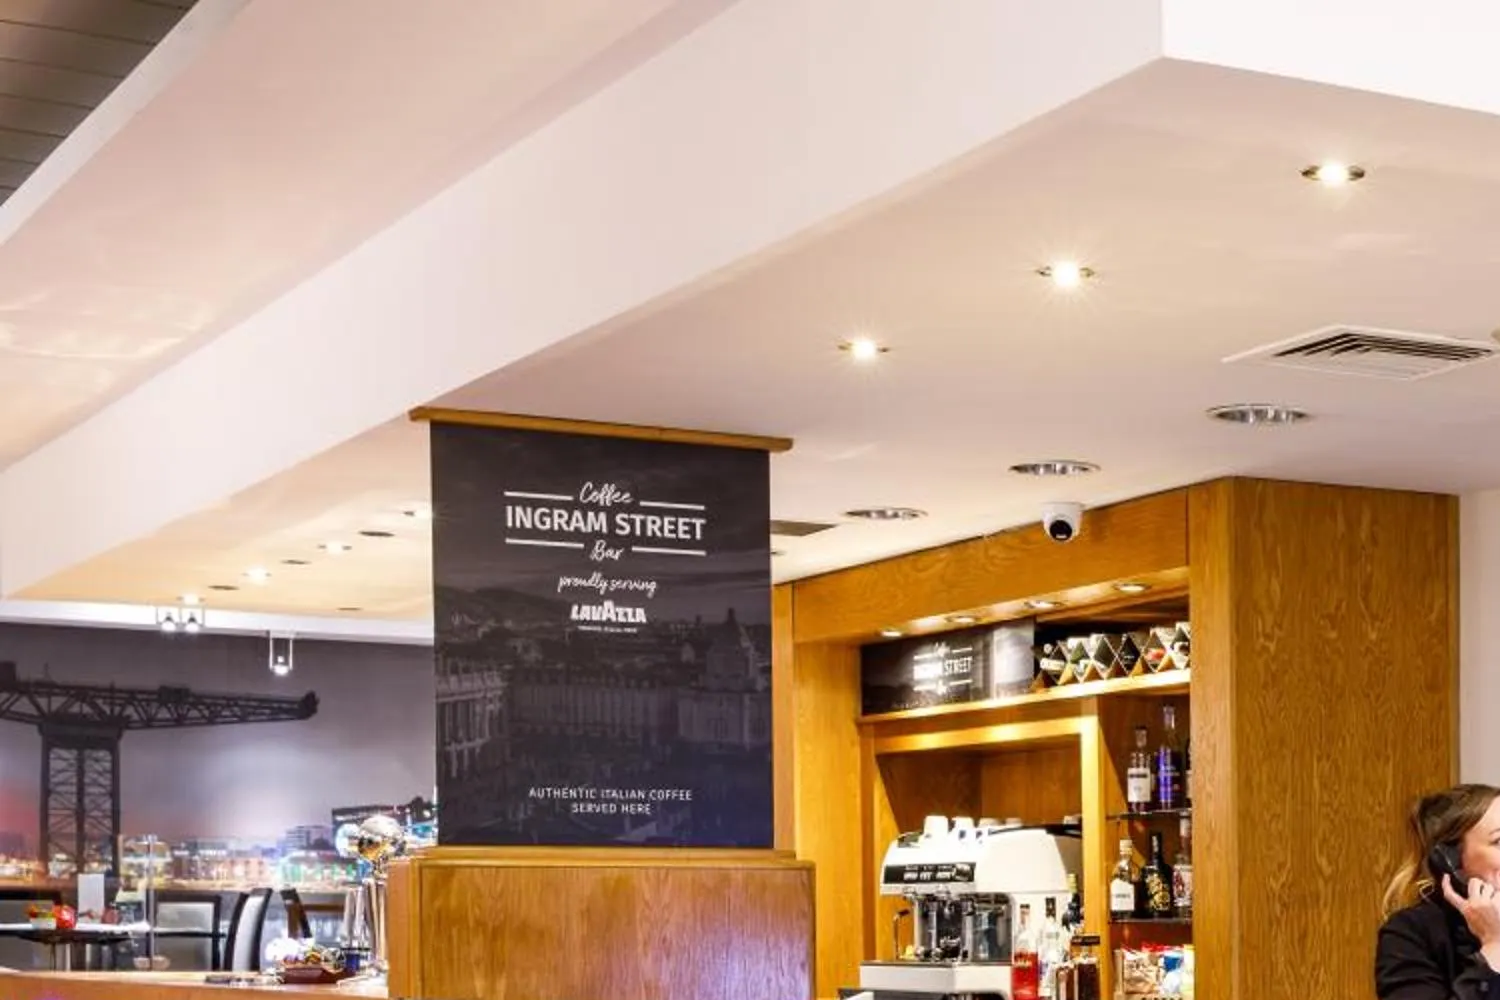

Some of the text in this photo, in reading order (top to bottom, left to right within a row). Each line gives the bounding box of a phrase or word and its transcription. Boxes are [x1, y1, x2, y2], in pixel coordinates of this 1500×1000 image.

[579, 481, 634, 506] Coffee
[505, 505, 706, 540] INGRAM STREET
[590, 540, 624, 561] Bar
[557, 571, 658, 598] proudly serving
[570, 600, 647, 623] LAVAZZA
[944, 656, 973, 676] STREET
[528, 786, 692, 800] AUTHENTIC ITALIAN COFFEE
[571, 802, 651, 815] SERVED HERE
